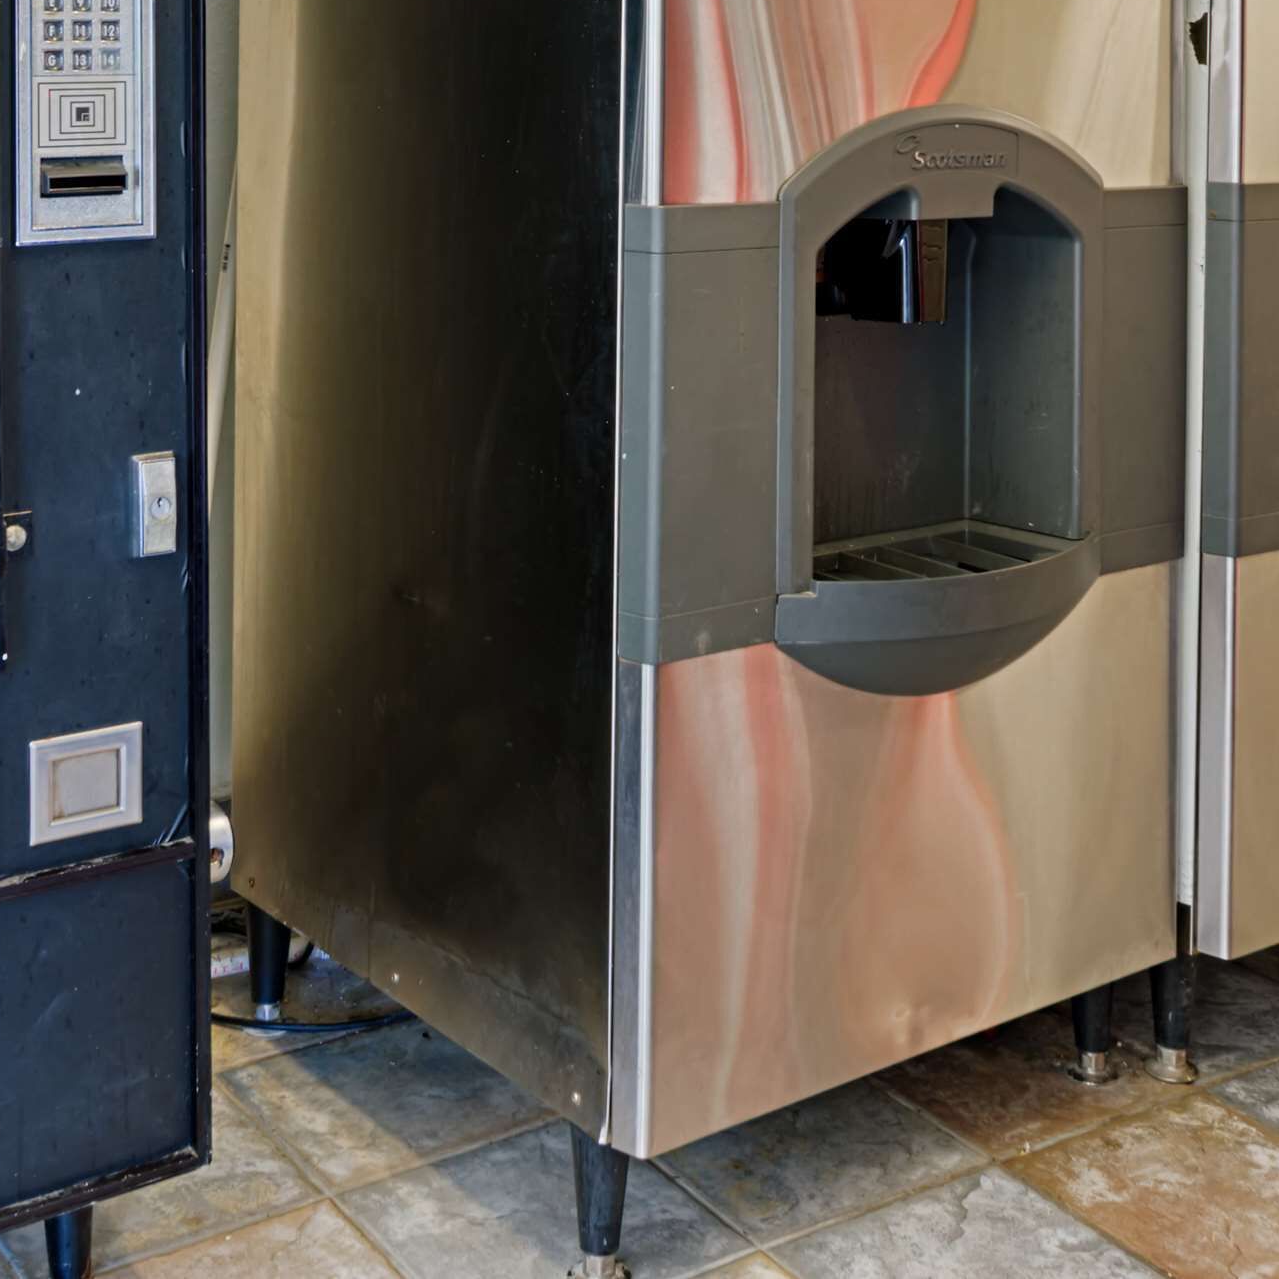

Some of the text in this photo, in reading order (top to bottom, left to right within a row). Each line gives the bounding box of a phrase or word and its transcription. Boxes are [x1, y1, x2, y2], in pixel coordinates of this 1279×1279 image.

[75, 25, 87, 38] 11
[103, 26, 116, 38] 12
[75, 55, 87, 68] 13
[103, 56, 115, 68] 14
[911, 151, 1008, 170] Scotsman
